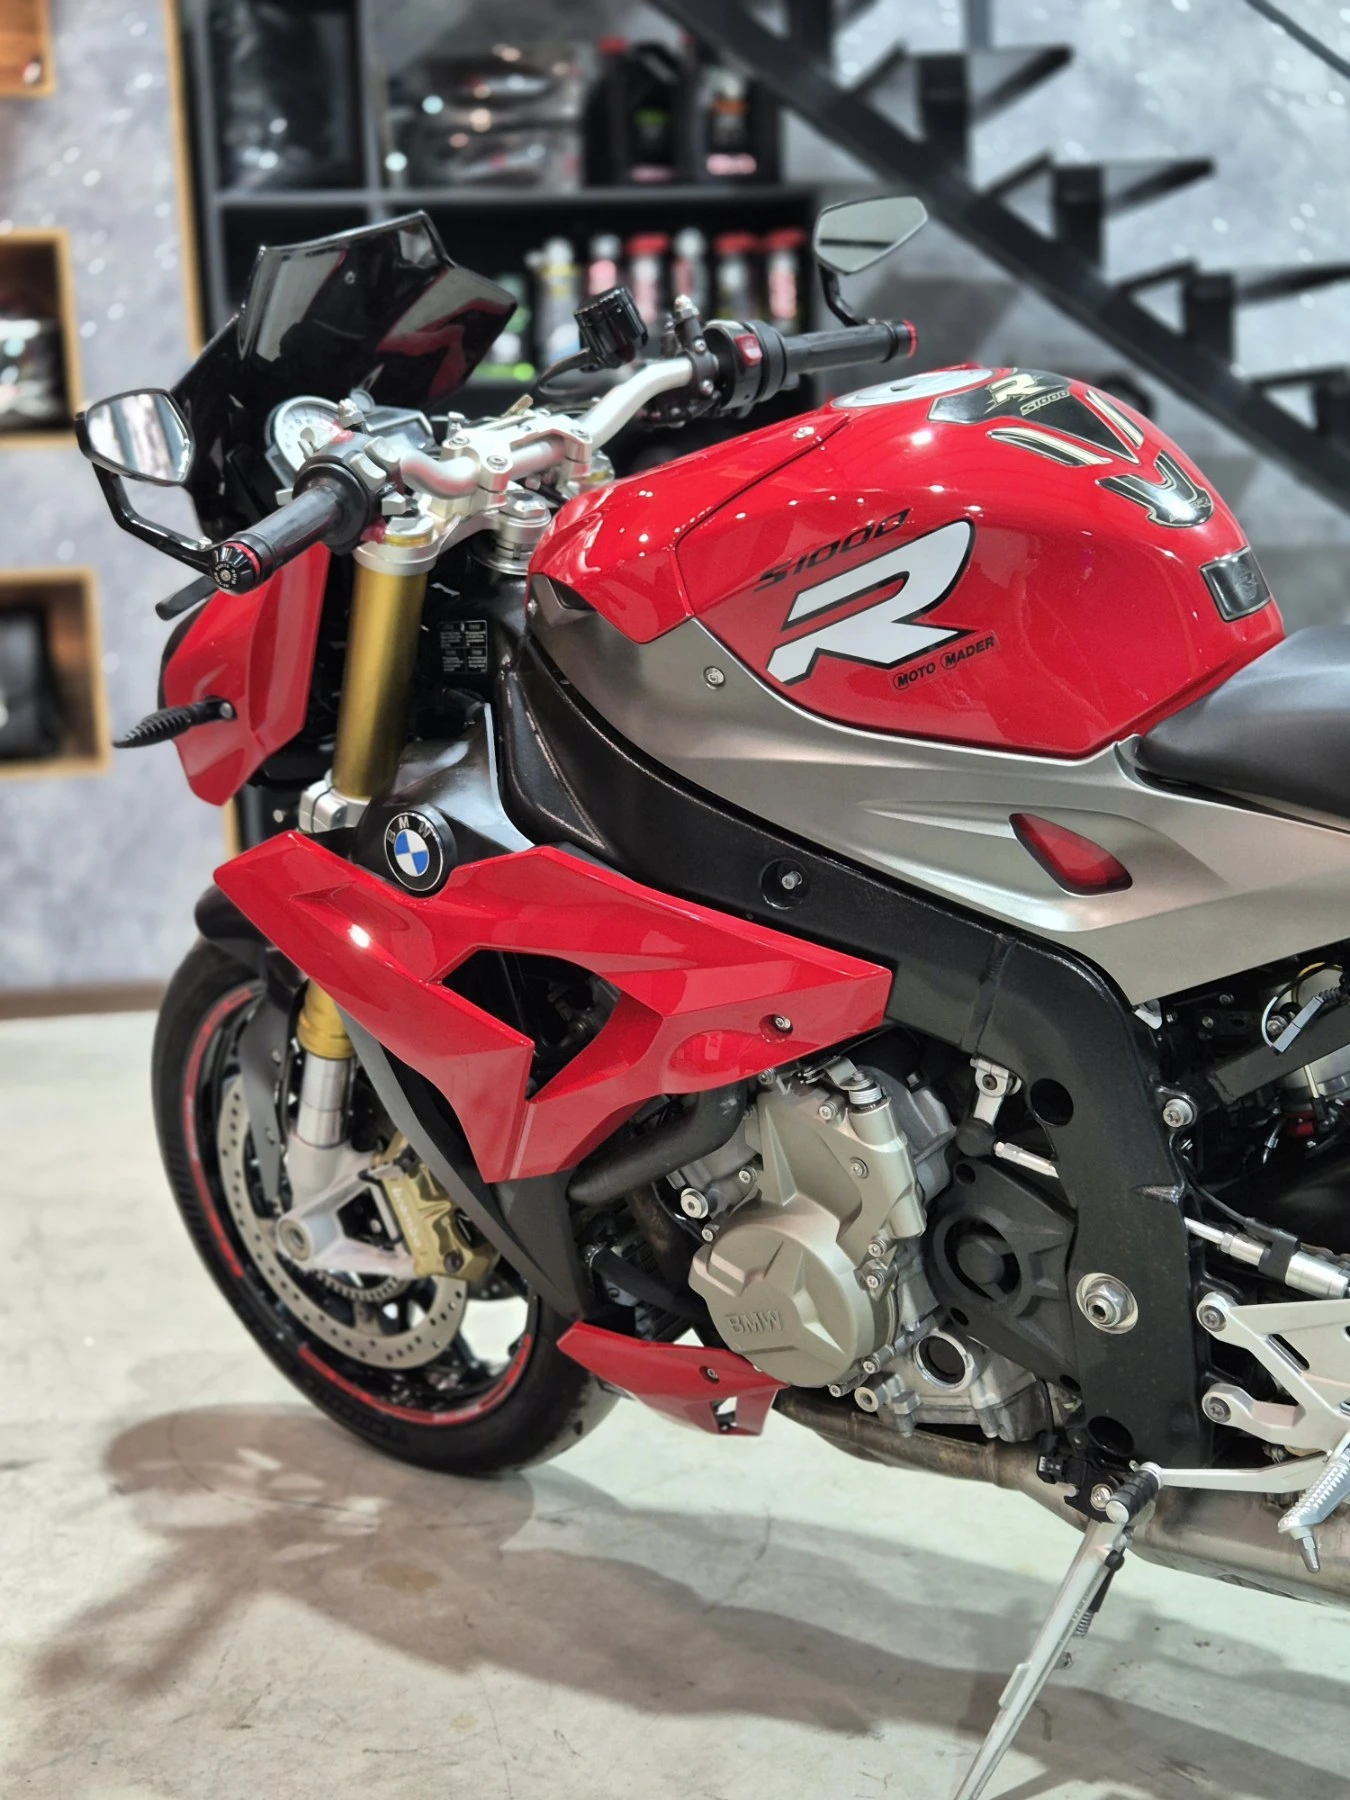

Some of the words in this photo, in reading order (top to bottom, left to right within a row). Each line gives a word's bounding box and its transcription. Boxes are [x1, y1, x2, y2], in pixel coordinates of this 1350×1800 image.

[1020, 390, 1071, 417] S1000
[754, 508, 913, 593] S1000
[765, 517, 979, 687] R
[893, 662, 937, 691] MOTO
[940, 635, 995, 671] MADER
[386, 815, 432, 844] BMW
[725, 1309, 782, 1334] BMW
